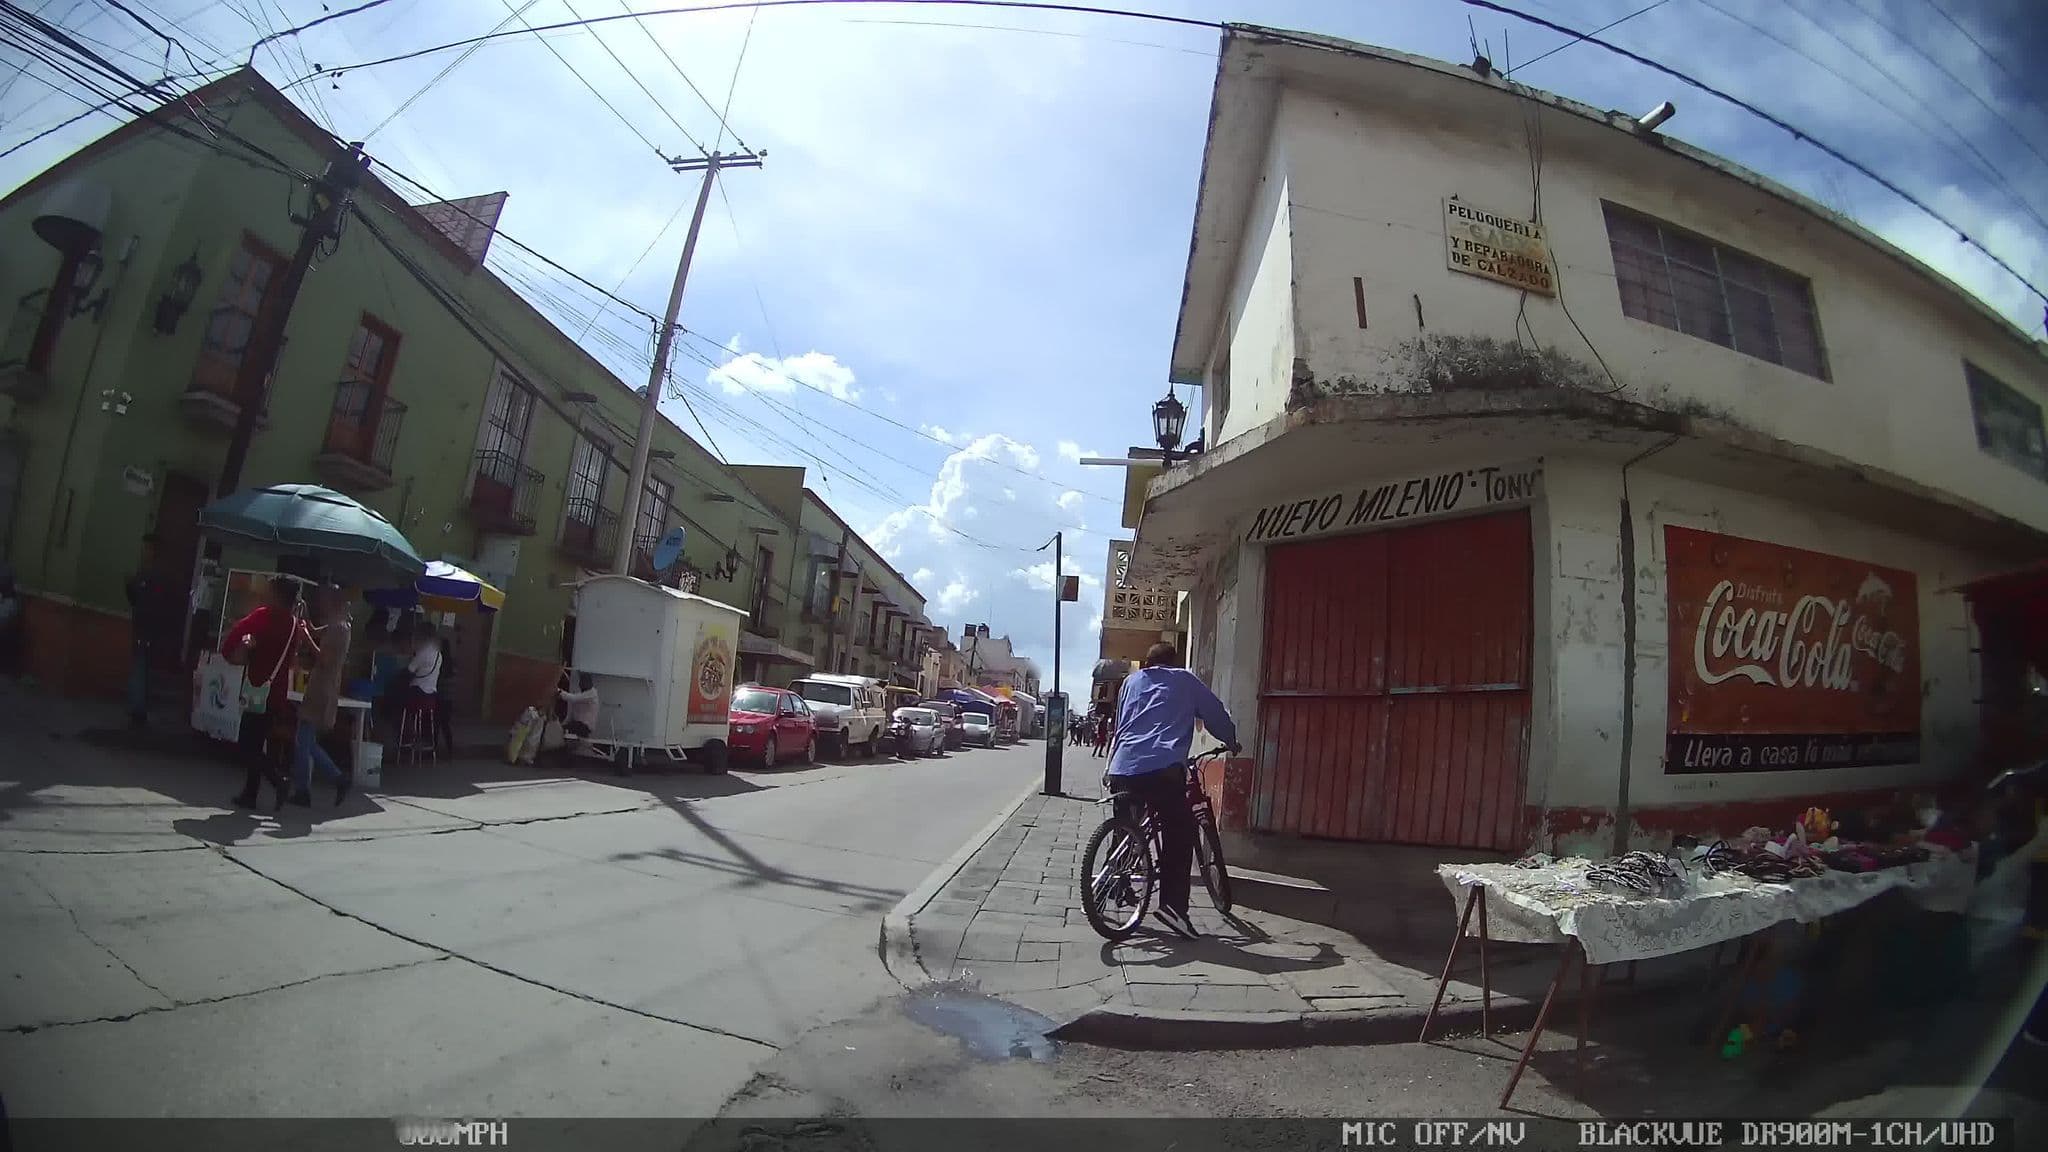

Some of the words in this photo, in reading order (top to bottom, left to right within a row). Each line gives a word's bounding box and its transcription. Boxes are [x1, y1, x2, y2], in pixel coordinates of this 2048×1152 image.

[1449, 203, 1542, 239] PELUQUERIA
[1451, 236, 1460, 248] Y
[1452, 251, 1471, 266] DE
[1477, 259, 1549, 288] CALZADO
[1246, 494, 1342, 542] NUEVO
[1345, 472, 1464, 526] MILENIO
[1694, 580, 1851, 690] Coca-Cola
[1685, 739, 1732, 767] Lleva
[1740, 746, 1751, 765] a
[1760, 746, 1798, 765] casa
